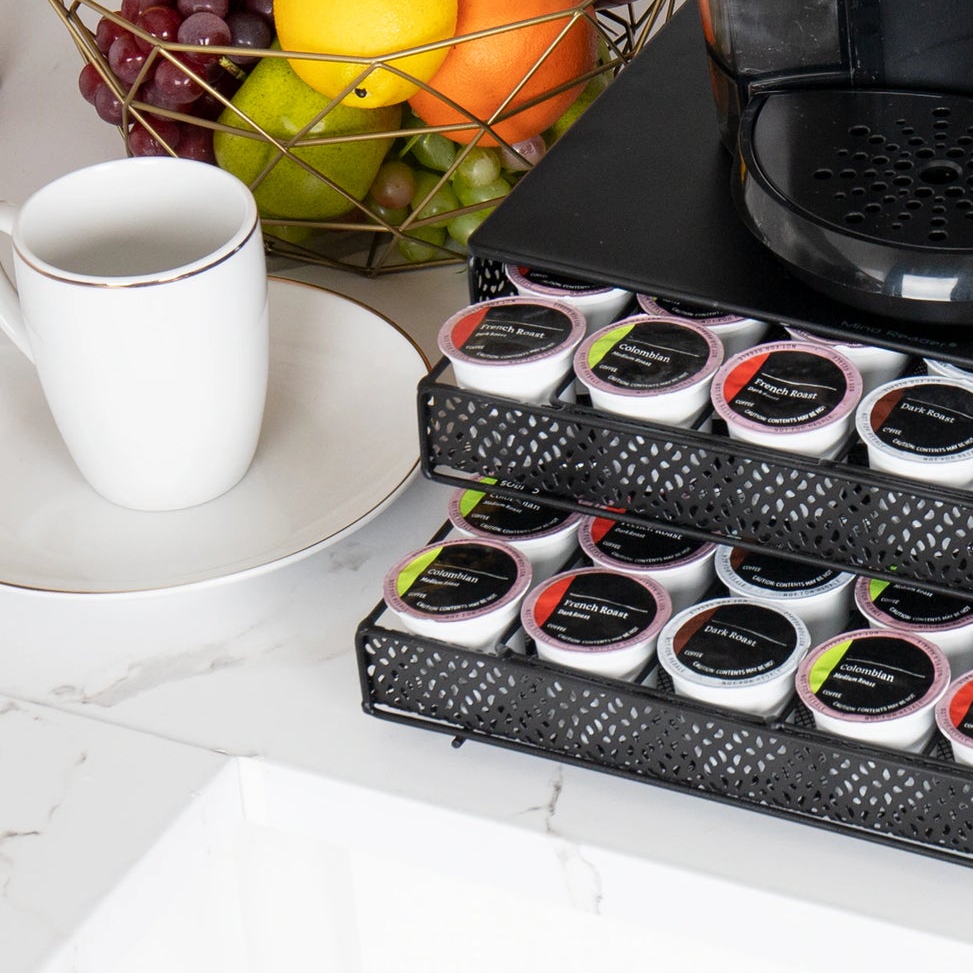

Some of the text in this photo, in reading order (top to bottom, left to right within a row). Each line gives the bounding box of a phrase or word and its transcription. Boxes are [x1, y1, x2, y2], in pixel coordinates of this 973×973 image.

[516, 328, 546, 339] Roast
[619, 343, 671, 363] Colombian
[754, 378, 818, 399] French Roast
[900, 403, 956, 424] Dark Roast
[427, 568, 479, 583] Colombian
[564, 599, 629, 619] French Roast
[704, 625, 757, 648] Dark Roast
[840, 663, 895, 683] Colombian
